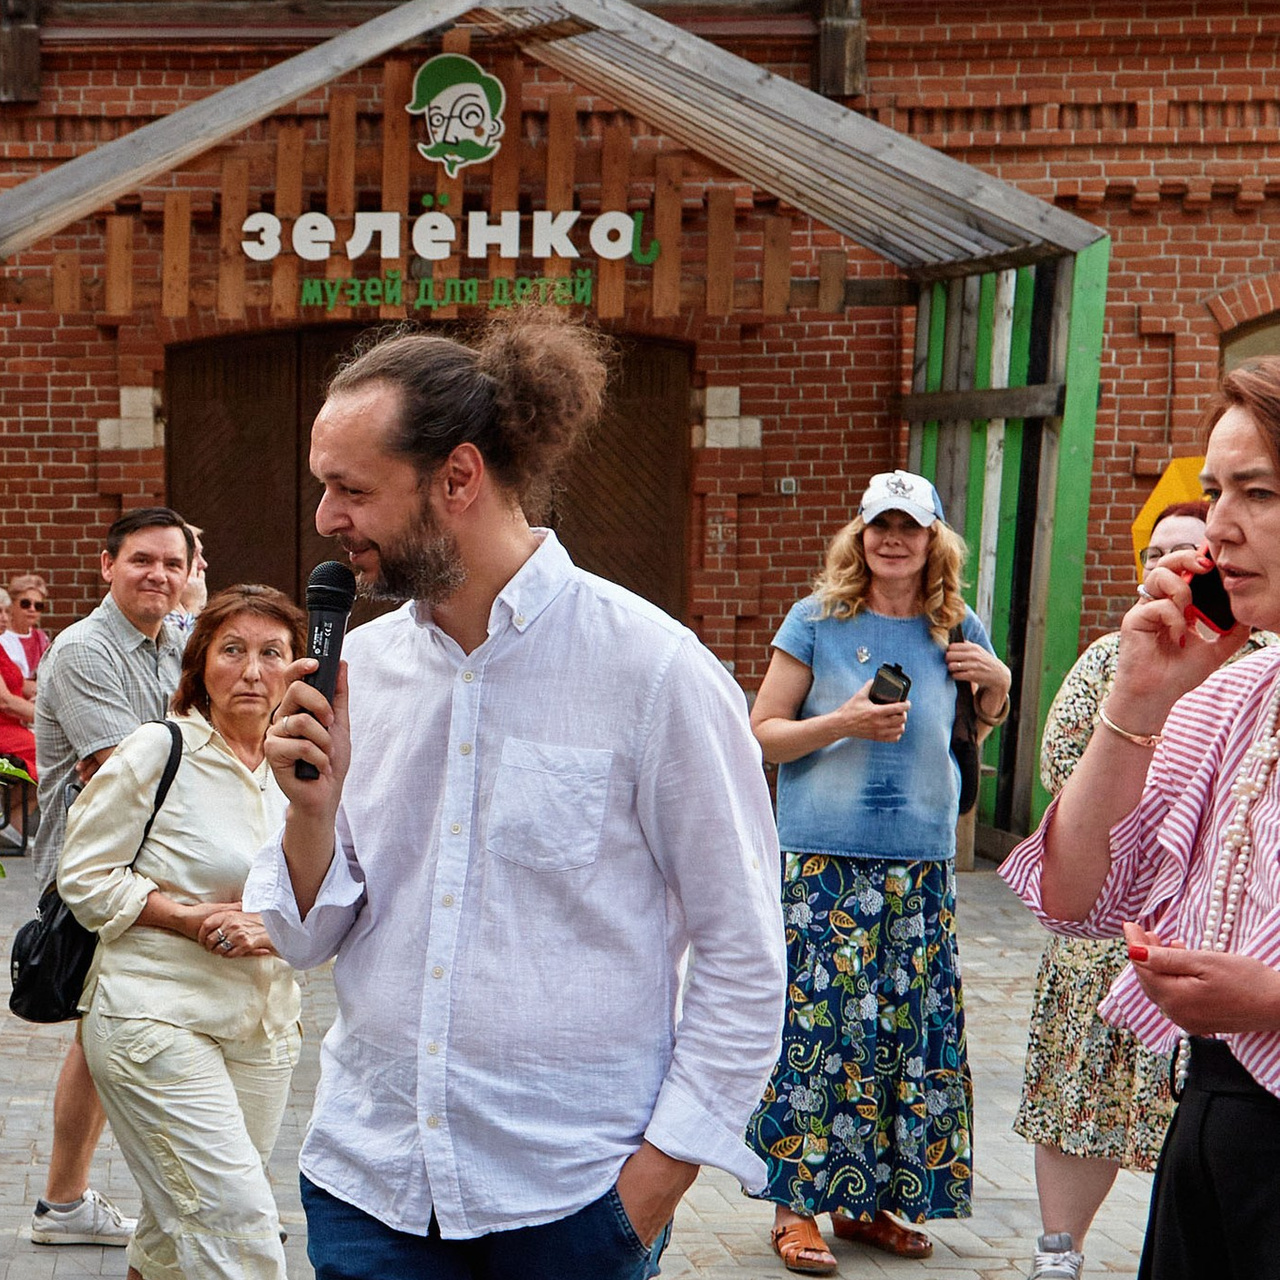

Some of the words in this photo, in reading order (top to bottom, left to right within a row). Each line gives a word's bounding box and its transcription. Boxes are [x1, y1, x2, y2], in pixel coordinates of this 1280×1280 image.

[241, 193, 660, 265] зелёнка
[301, 270, 402, 311] музей
[414, 278, 479, 311] для
[488, 270, 593, 311] детей
